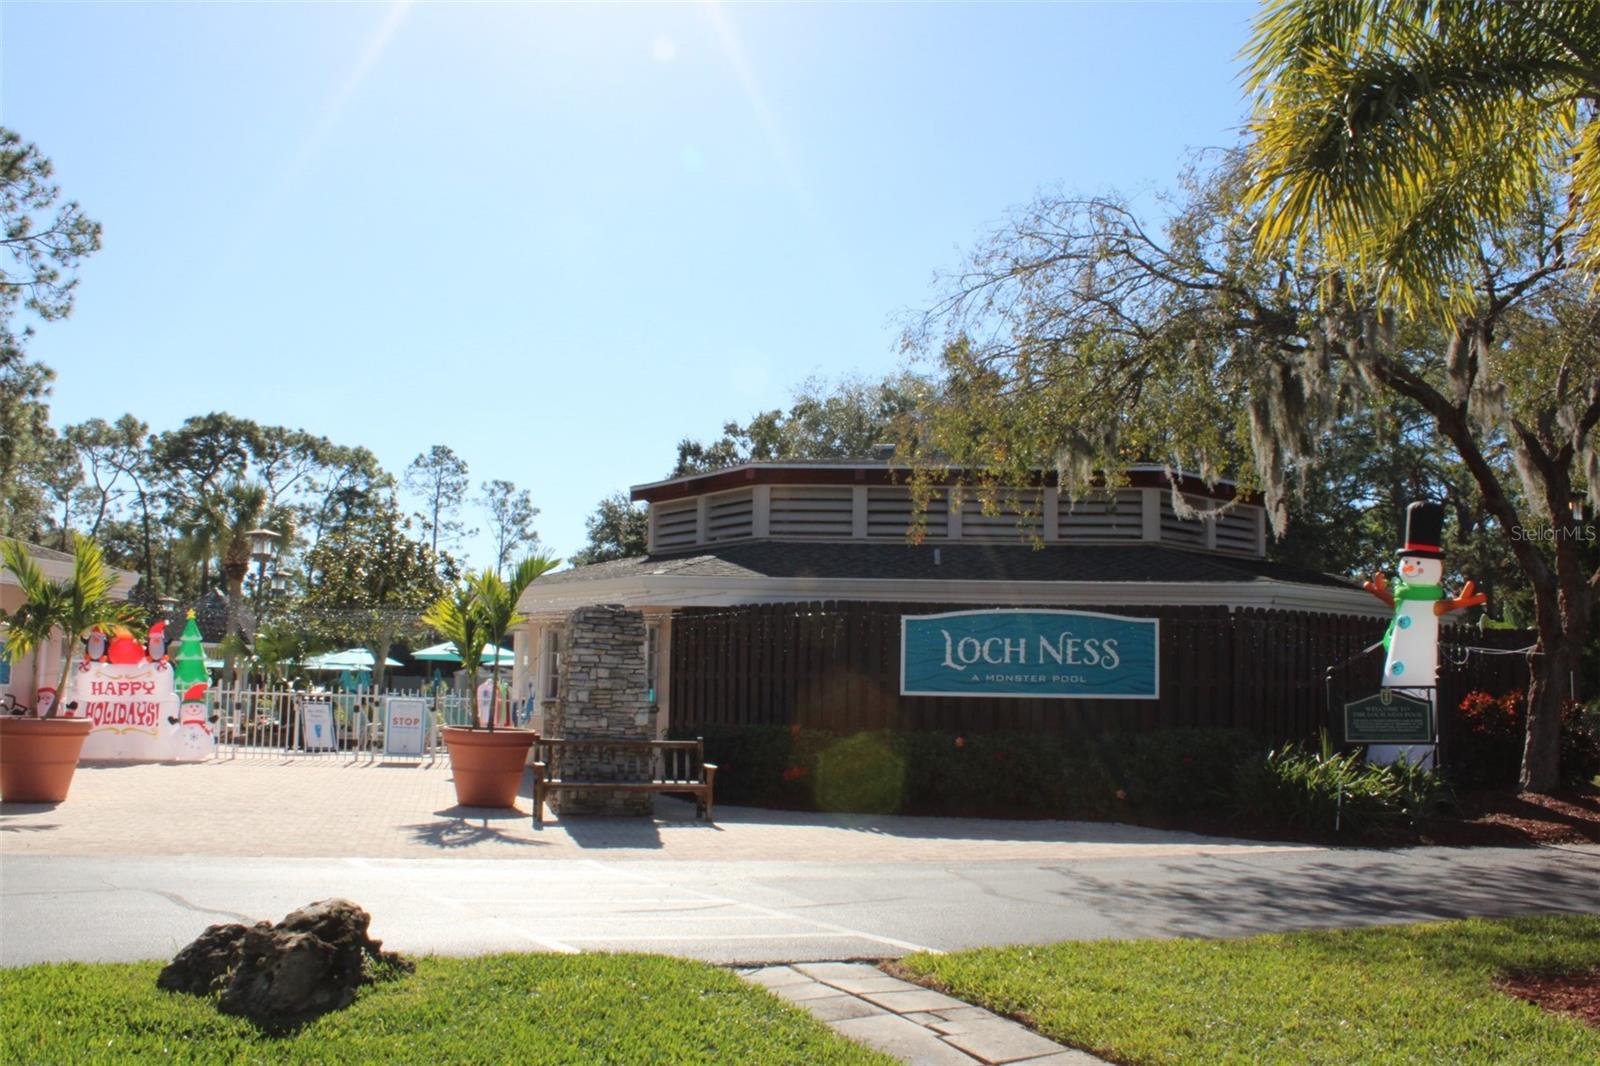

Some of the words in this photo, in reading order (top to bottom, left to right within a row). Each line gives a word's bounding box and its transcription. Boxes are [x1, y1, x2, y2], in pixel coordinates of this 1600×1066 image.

[941, 629, 1026, 671] LOCH
[1039, 631, 1120, 670] NESS
[971, 674, 980, 682] A
[986, 674, 1046, 682] MONSTER
[91, 681, 155, 695] HAPPY
[85, 701, 160, 727] HOLIDAYS!
[392, 716, 420, 726] STOP
